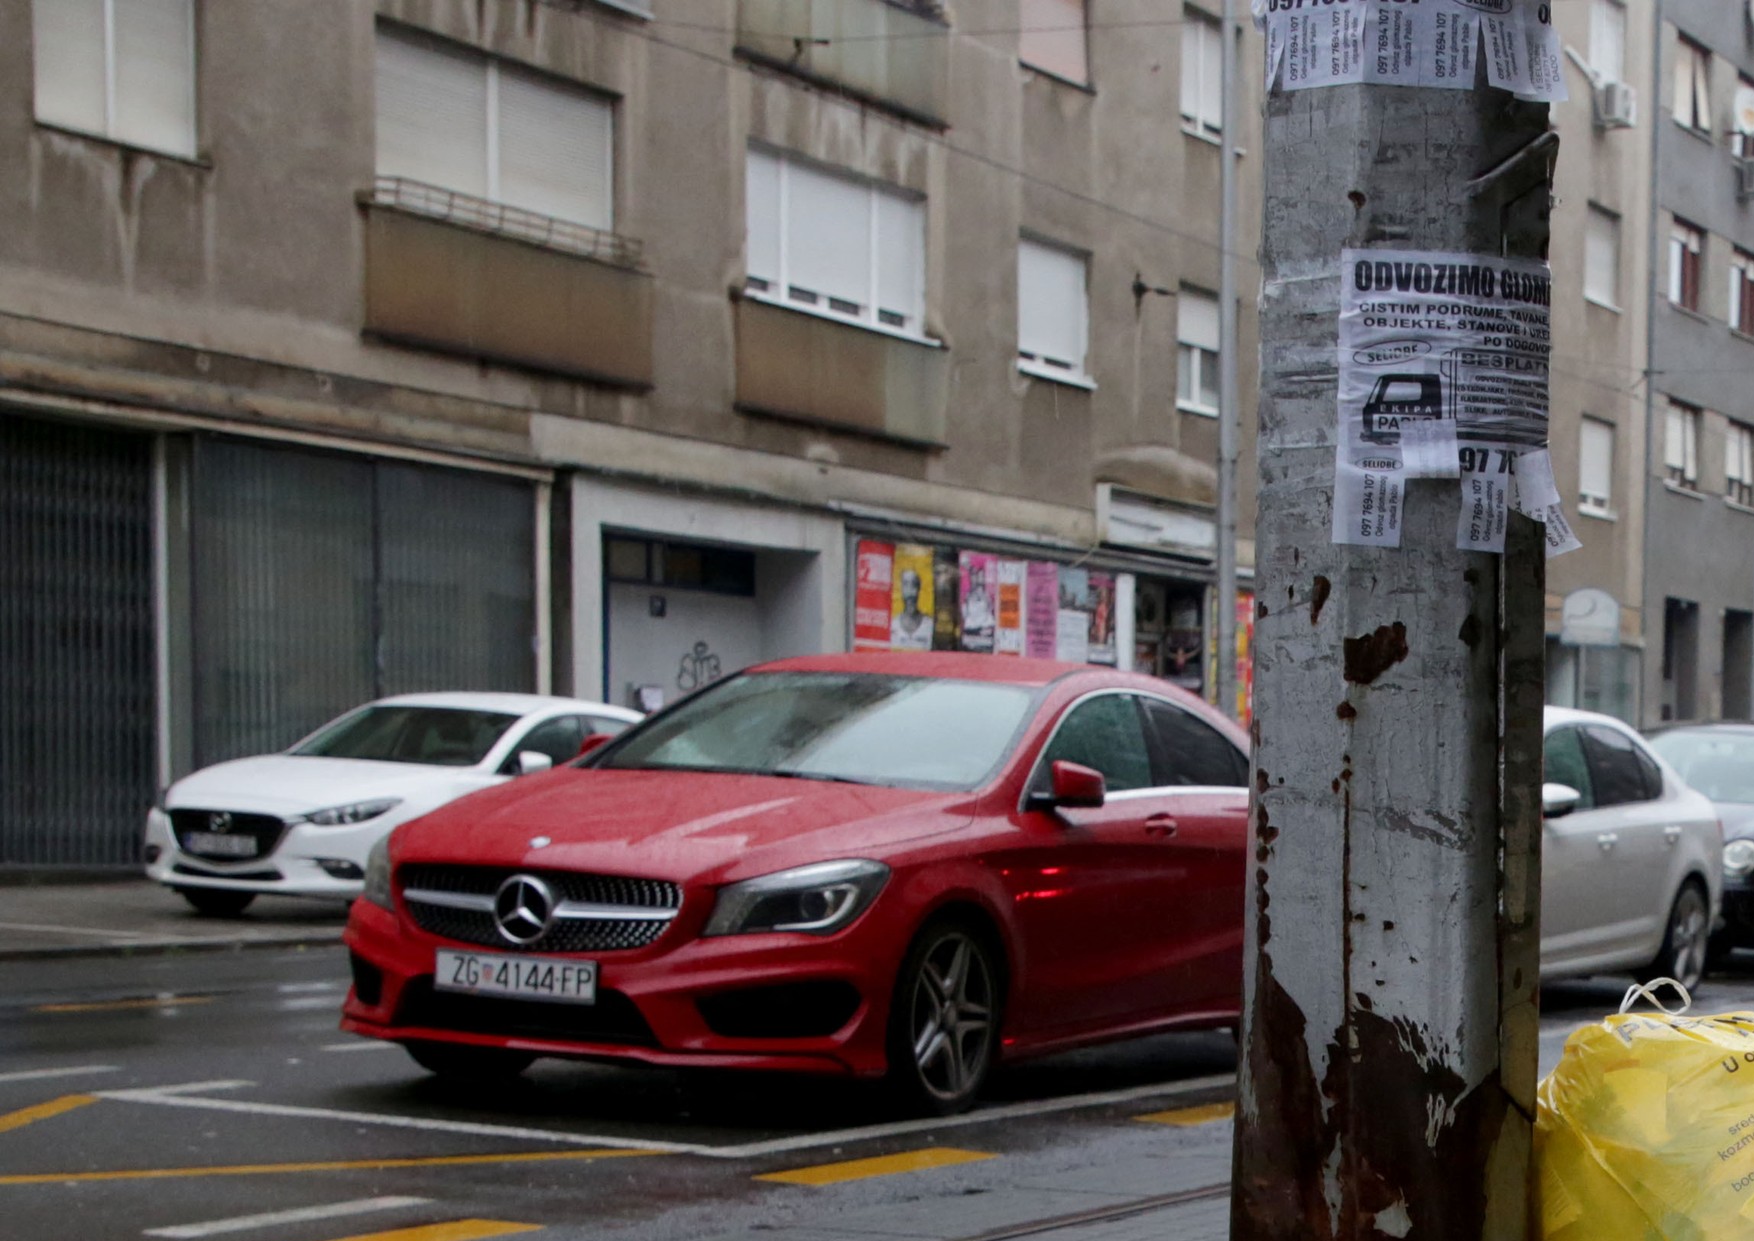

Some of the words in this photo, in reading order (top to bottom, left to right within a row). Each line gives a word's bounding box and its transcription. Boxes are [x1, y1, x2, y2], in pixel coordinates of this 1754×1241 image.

[1290, 16, 1298, 33] 107
[1332, 11, 1340, 28] 107
[1379, 8, 1389, 26] 107
[1437, 12, 1446, 29] 107
[1378, 28, 1388, 56] 7694
[1436, 31, 1446, 57] 7694
[1290, 60, 1298, 81] 097
[1377, 57, 1387, 75] 097
[1436, 58, 1445, 78] 097
[1354, 260, 1496, 298] ODVOZIMO
[1426, 303, 1507, 320] PODRUME,
[1363, 317, 1452, 331] OBJEKTE,
[1457, 319, 1521, 335] STANOVE
[1483, 335, 1501, 347] PO
[1379, 404, 1433, 414] EKIPA
[1362, 460, 1397, 470] SELIDBE
[1364, 474, 1375, 488] 107
[1473, 479, 1482, 494] 107
[1362, 490, 1373, 515] 7694
[1471, 495, 1482, 520] 7694
[1362, 516, 1372, 537] 097
[1470, 520, 1479, 542] 097
[453, 956, 479, 986] ZG
[1723, 1057, 1740, 1074] U
